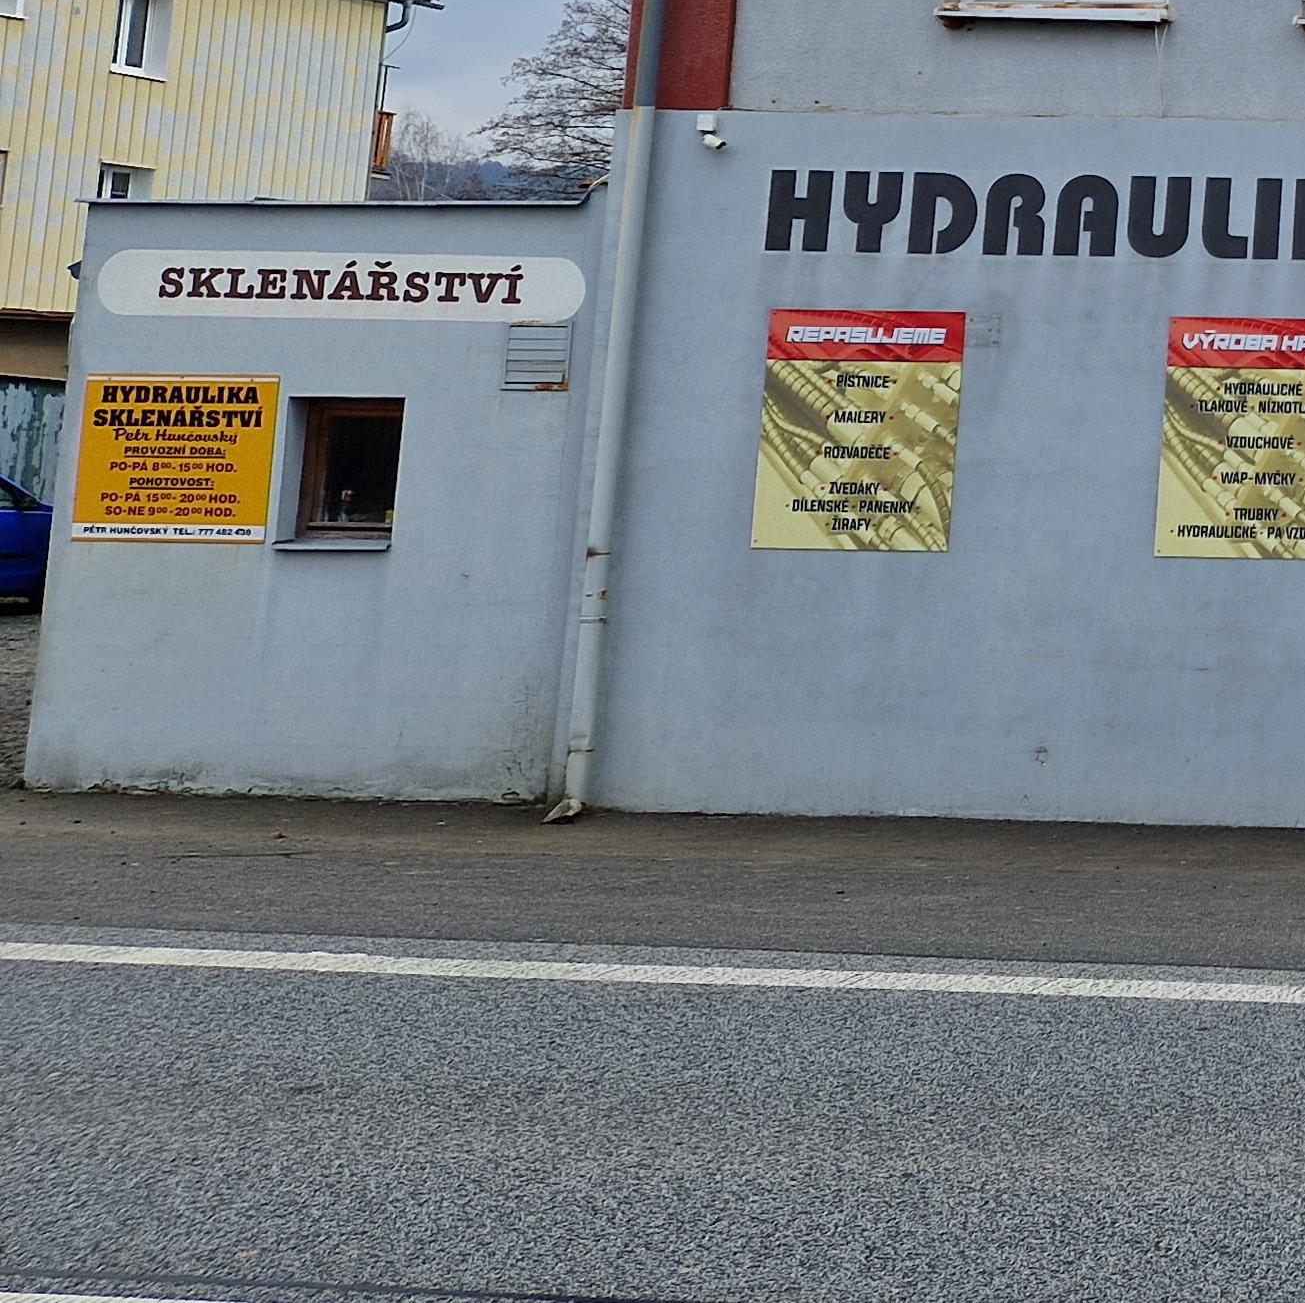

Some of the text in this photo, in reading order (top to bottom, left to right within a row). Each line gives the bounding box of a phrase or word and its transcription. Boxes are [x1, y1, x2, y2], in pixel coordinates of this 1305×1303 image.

[158, 260, 525, 306] SKLENÁŘSTVÍ
[786, 326, 947, 344] REPASUJEME
[1182, 329, 1278, 351] VÝROBA
[836, 372, 891, 388] PÍSTNICE
[101, 385, 260, 404] HYDRAULIKA
[1224, 381, 1304, 396] HYDRAULICKÉ
[1198, 398, 1249, 413] TLAKOVÉ
[93, 406, 264, 428] SKLENÁŘSTVÍ
[113, 428, 151, 442] Petr
[1226, 435, 1295, 450] VZDUCHOVÉ
[124, 445, 227, 457] PROVOZNÍ DOBA:
[823, 445, 891, 460] ROZVADĚČE
[206, 463, 238, 473] HOD.
[129, 477, 215, 488] POHOTOVOST:
[828, 480, 881, 495] ZVEDÁKY
[209, 494, 241, 504] HOD.
[791, 497, 916, 514] DÍLENSKÉ PANENKY
[105, 506, 145, 516] SO-NE
[204, 507, 236, 518] HOD.
[1233, 508, 1279, 522] TRUBKY
[831, 516, 872, 531] ŽIRAFY
[1177, 523, 1257, 539] HYDRAULICKÉ
